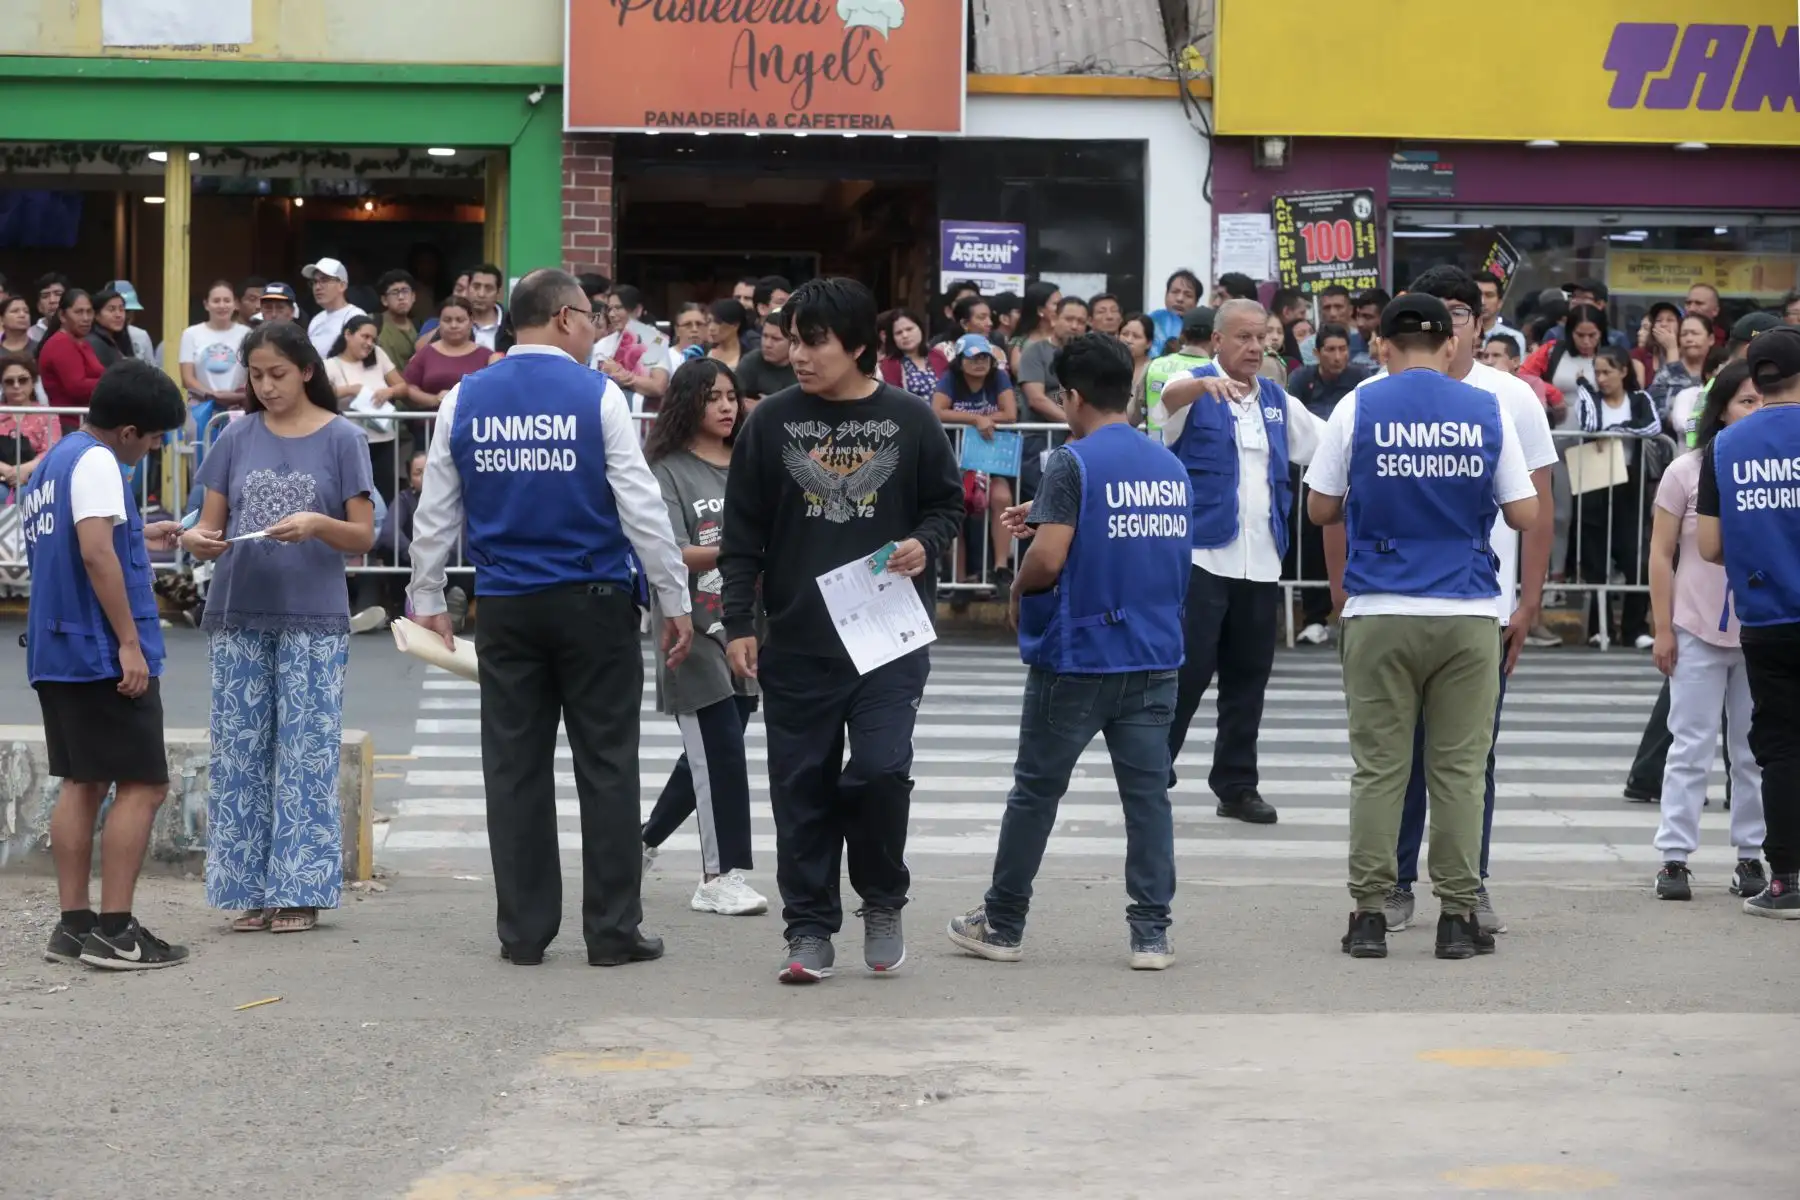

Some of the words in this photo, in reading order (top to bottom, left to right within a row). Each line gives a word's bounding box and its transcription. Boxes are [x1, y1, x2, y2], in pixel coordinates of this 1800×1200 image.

[729, 25, 892, 111] Angel's
[645, 109, 760, 127] PANADERÍA
[766, 112, 778, 128] &
[784, 113, 895, 129] CAFETERIA
[1300, 219, 1354, 264] 100
[472, 414, 577, 443] UNMSM
[783, 420, 832, 440] WILD
[1374, 421, 1483, 448] UNMSM
[474, 447, 577, 473] SEGURIDAD
[835, 446, 851, 455] AND
[1376, 453, 1484, 478] SEGURIDAD
[1105, 480, 1187, 508] UNMSM
[805, 504, 822, 517] 19
[857, 504, 876, 518] 72
[1107, 513, 1187, 539] SEGURIDAD
